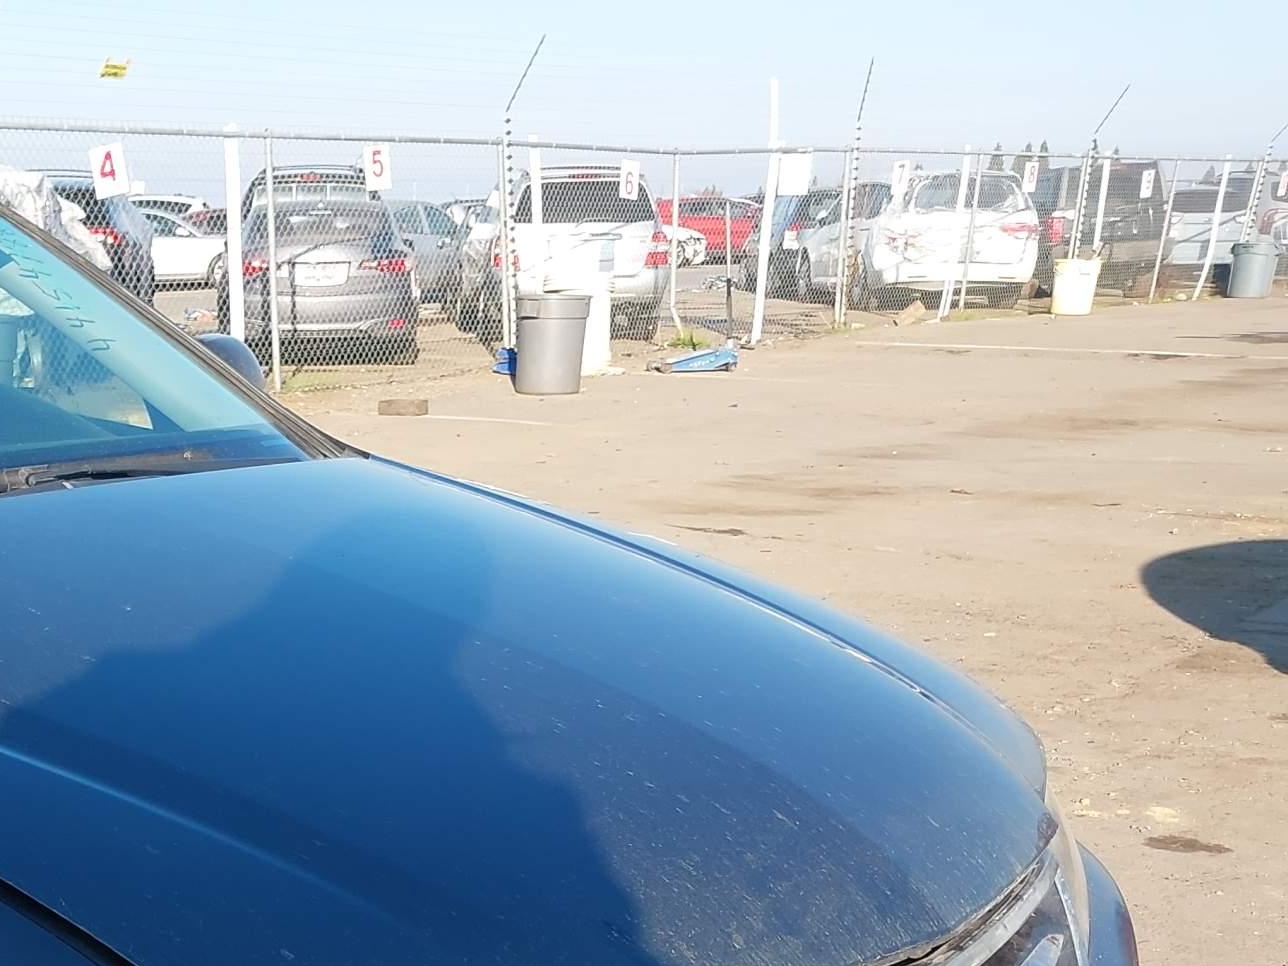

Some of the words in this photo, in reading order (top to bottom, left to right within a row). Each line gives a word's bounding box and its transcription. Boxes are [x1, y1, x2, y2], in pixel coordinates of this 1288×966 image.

[99, 150, 117, 182] 4
[371, 150, 385, 178] 5
[624, 170, 635, 195] 6
